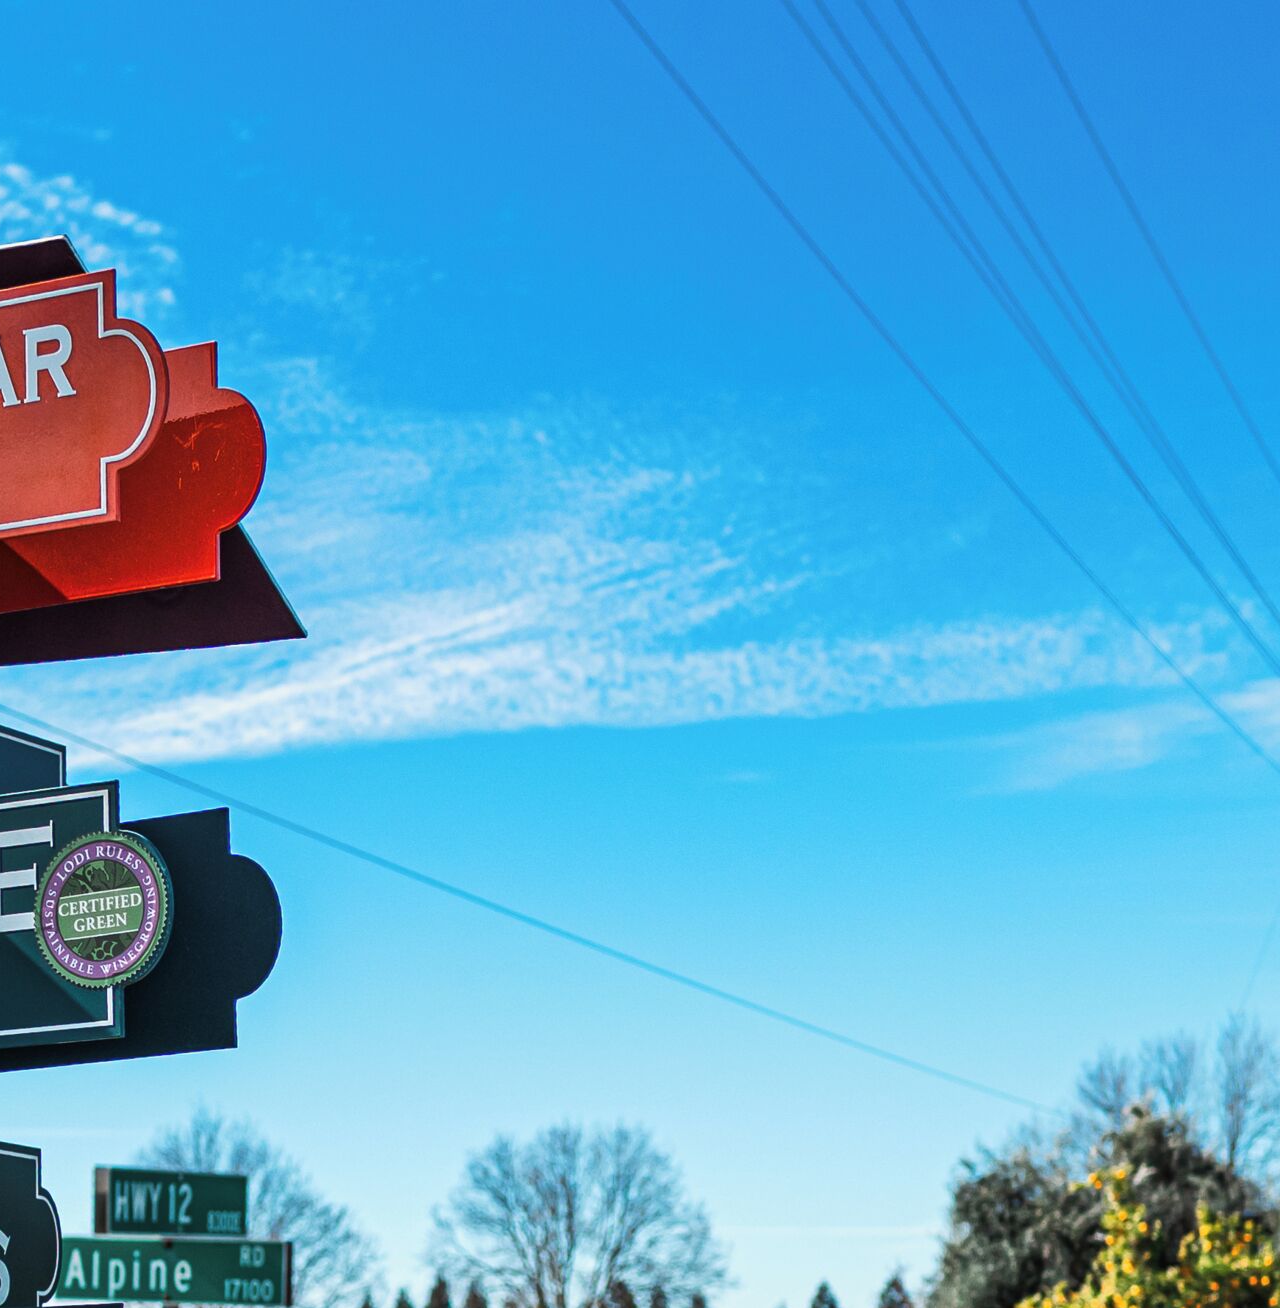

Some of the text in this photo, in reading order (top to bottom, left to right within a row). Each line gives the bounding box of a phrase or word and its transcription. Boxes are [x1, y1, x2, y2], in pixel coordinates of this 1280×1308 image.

[56, 845, 143, 882] LODI RULES
[58, 892, 142, 917] CERTIFIED
[74, 912, 128, 933] GREEN
[44, 876, 157, 976] SUSTAINABLE WINEGROWING
[113, 1180, 193, 1225] HWY 12
[64, 1245, 265, 1298] Alpine RD
[224, 1278, 274, 1301] 17100
